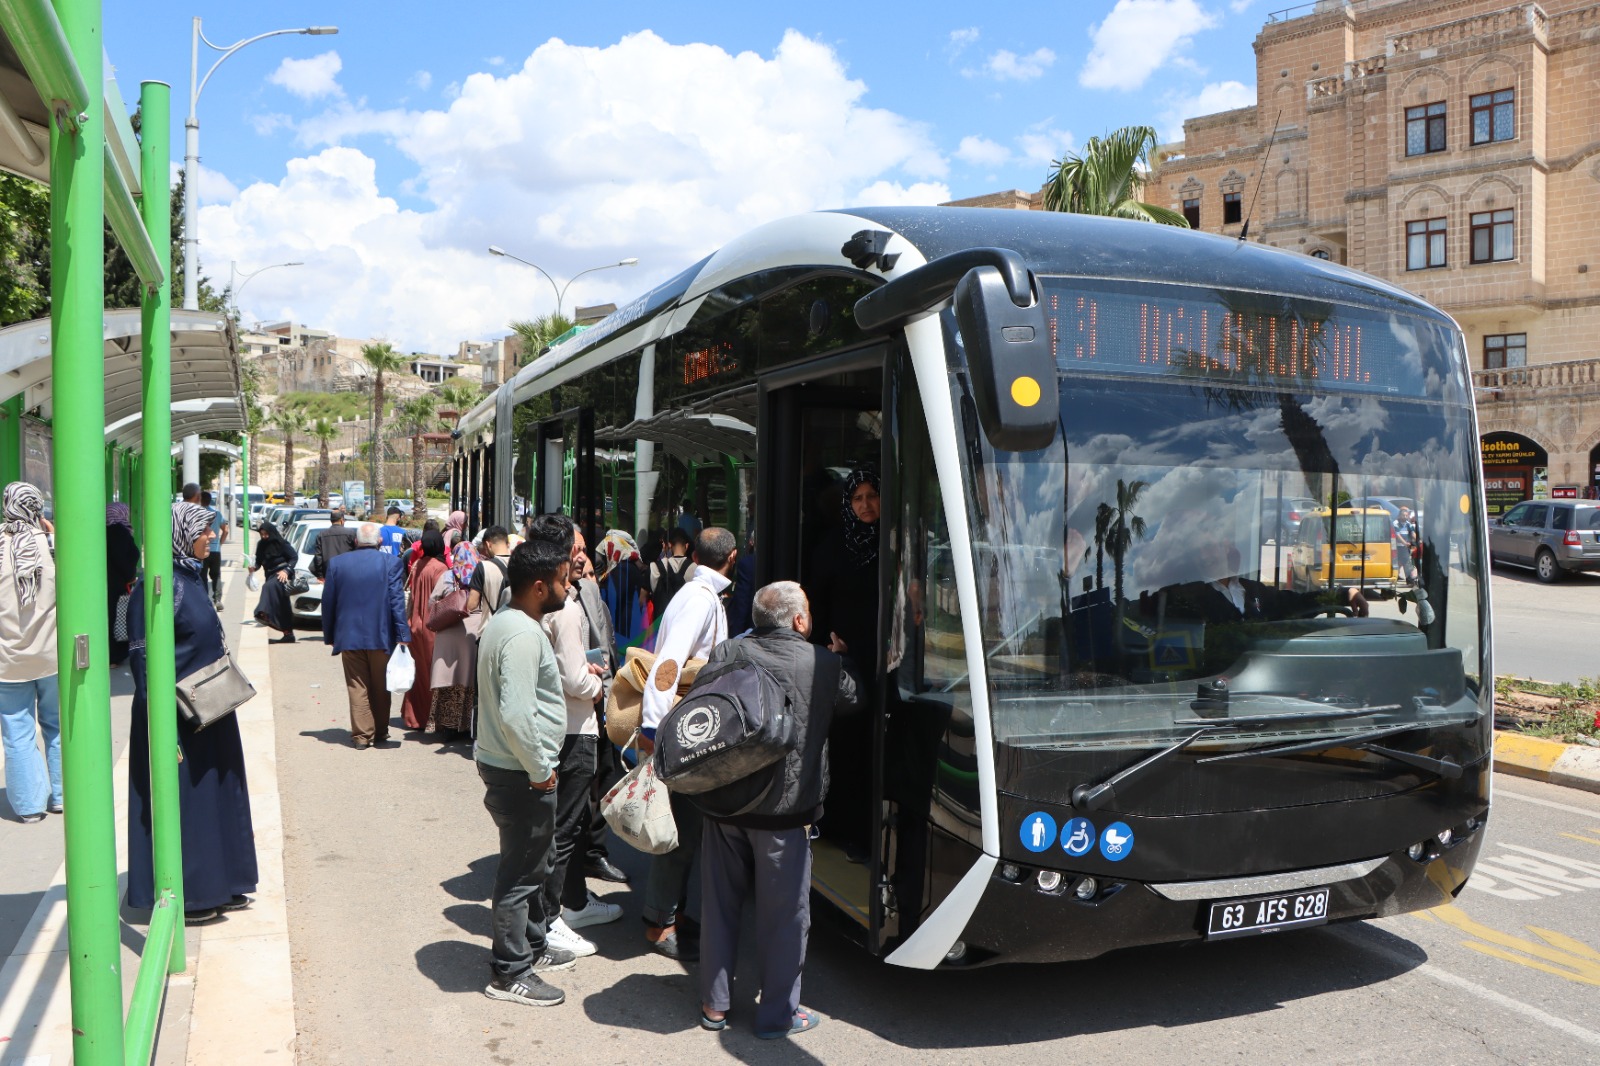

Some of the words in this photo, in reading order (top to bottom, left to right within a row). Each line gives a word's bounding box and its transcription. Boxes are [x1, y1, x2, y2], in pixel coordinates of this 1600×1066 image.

[1222, 904, 1245, 929] 63
[1255, 898, 1288, 925] AFS
[1294, 892, 1325, 918] 628
